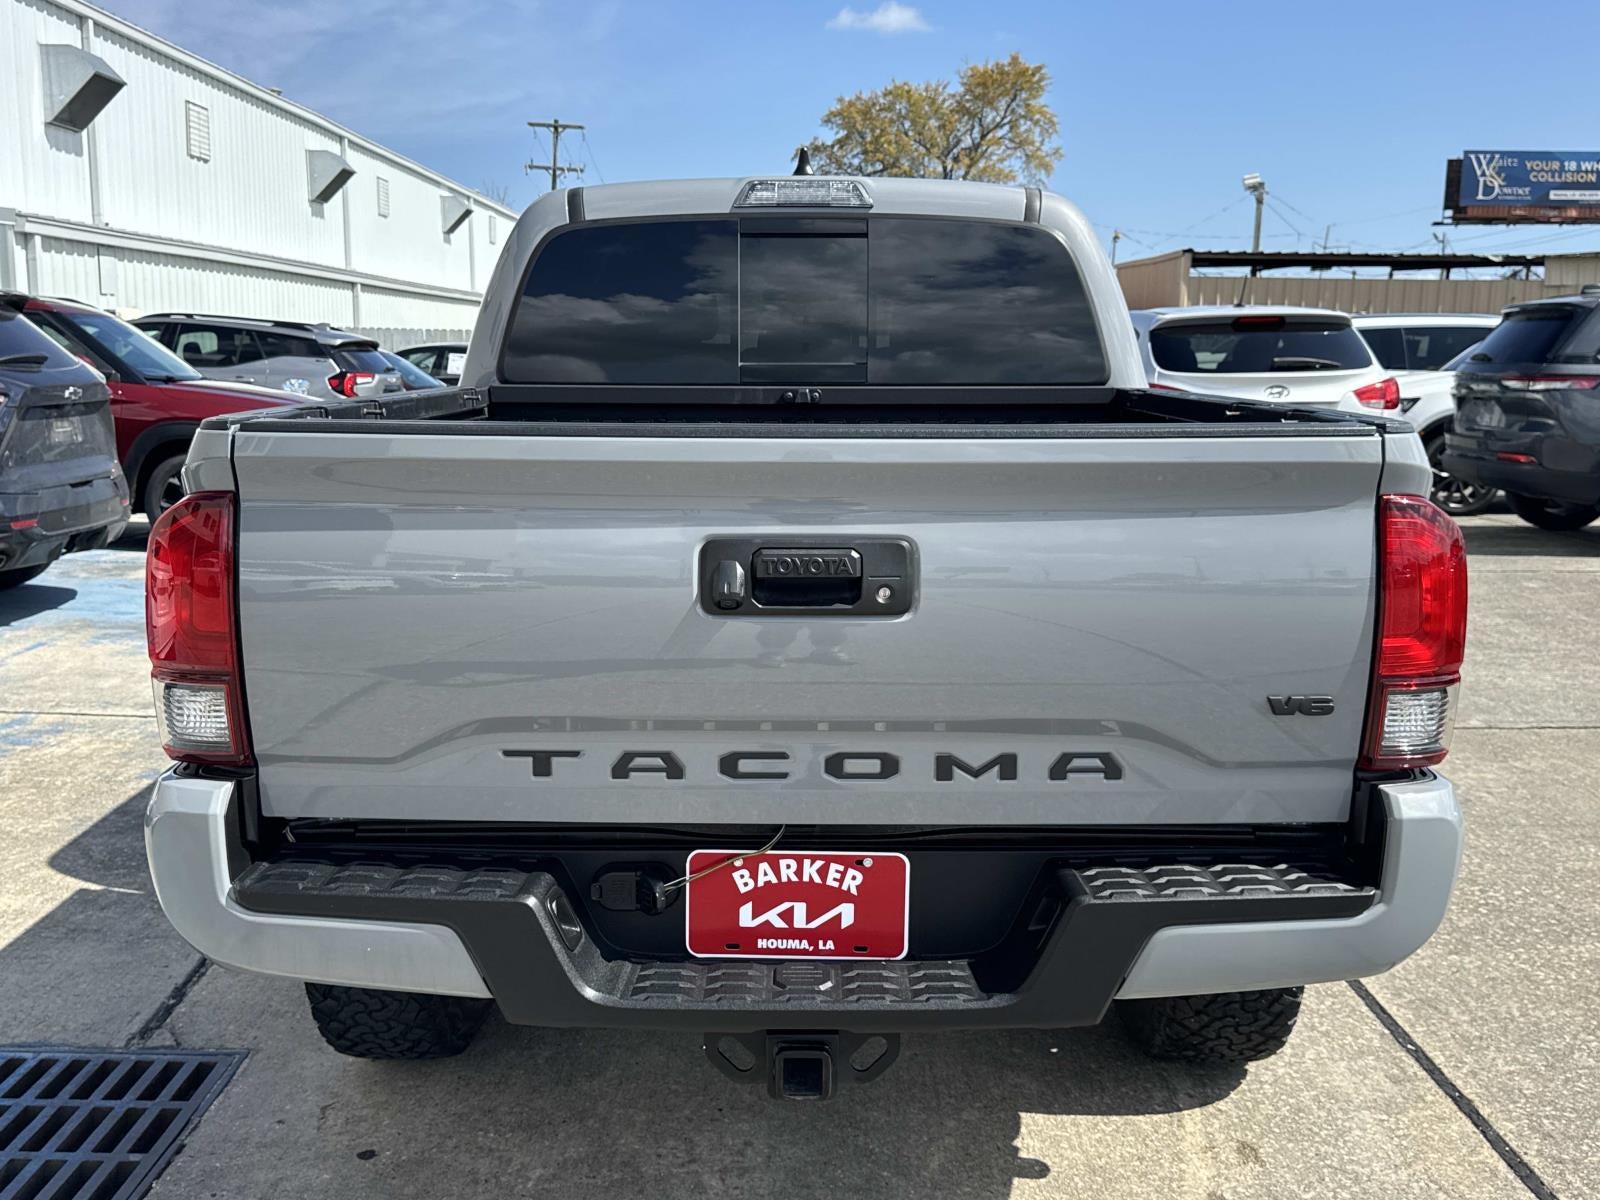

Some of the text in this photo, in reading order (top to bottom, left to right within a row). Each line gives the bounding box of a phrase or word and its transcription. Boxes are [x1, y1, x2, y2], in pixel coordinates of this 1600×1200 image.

[1525, 160, 1560, 171] YOUR
[1563, 161, 1577, 171] 18
[1529, 172, 1597, 183] COLLISION
[762, 557, 854, 576] TOYOTA
[1266, 695, 1335, 716] V6
[501, 750, 1124, 782] TACOMA
[731, 858, 864, 896] BARKER
[757, 938, 835, 951] HOUMA, LA
